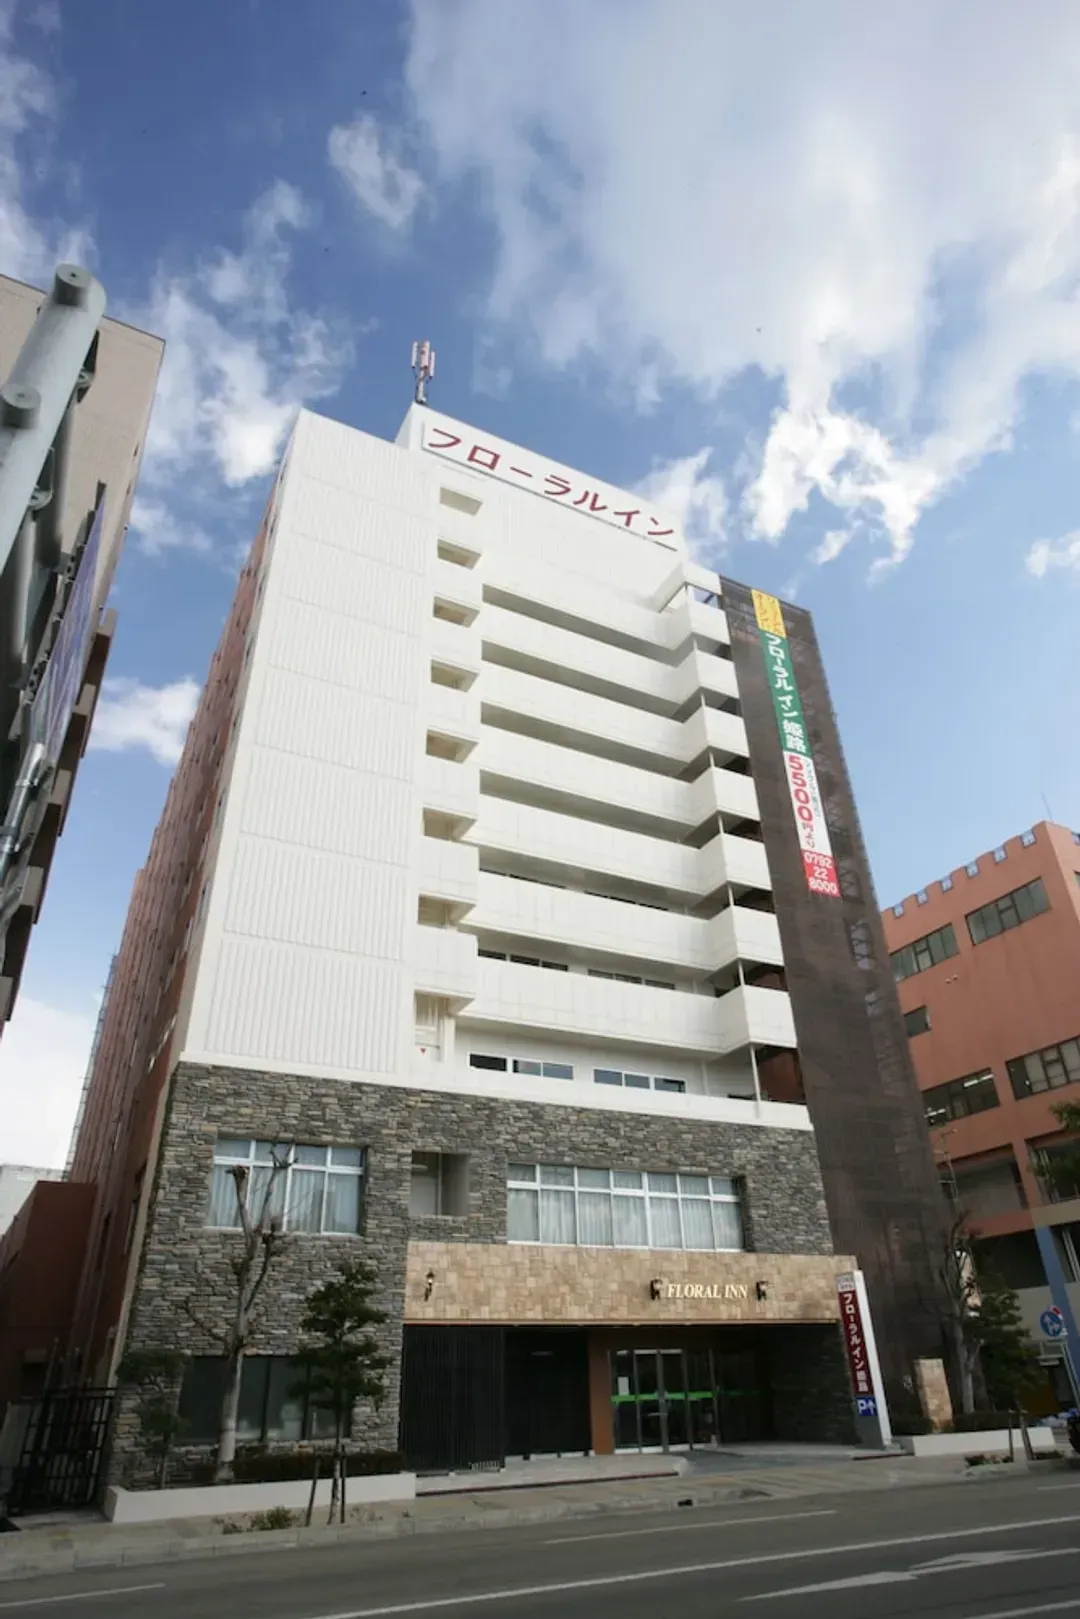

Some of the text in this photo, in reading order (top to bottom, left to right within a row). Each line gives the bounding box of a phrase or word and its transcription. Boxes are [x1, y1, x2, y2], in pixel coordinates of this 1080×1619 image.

[428, 428, 674, 536] フローラルイン
[813, 867, 828, 879] 22
[667, 1284, 749, 1298] FLORAL INN
[857, 1399, 867, 1415] P
